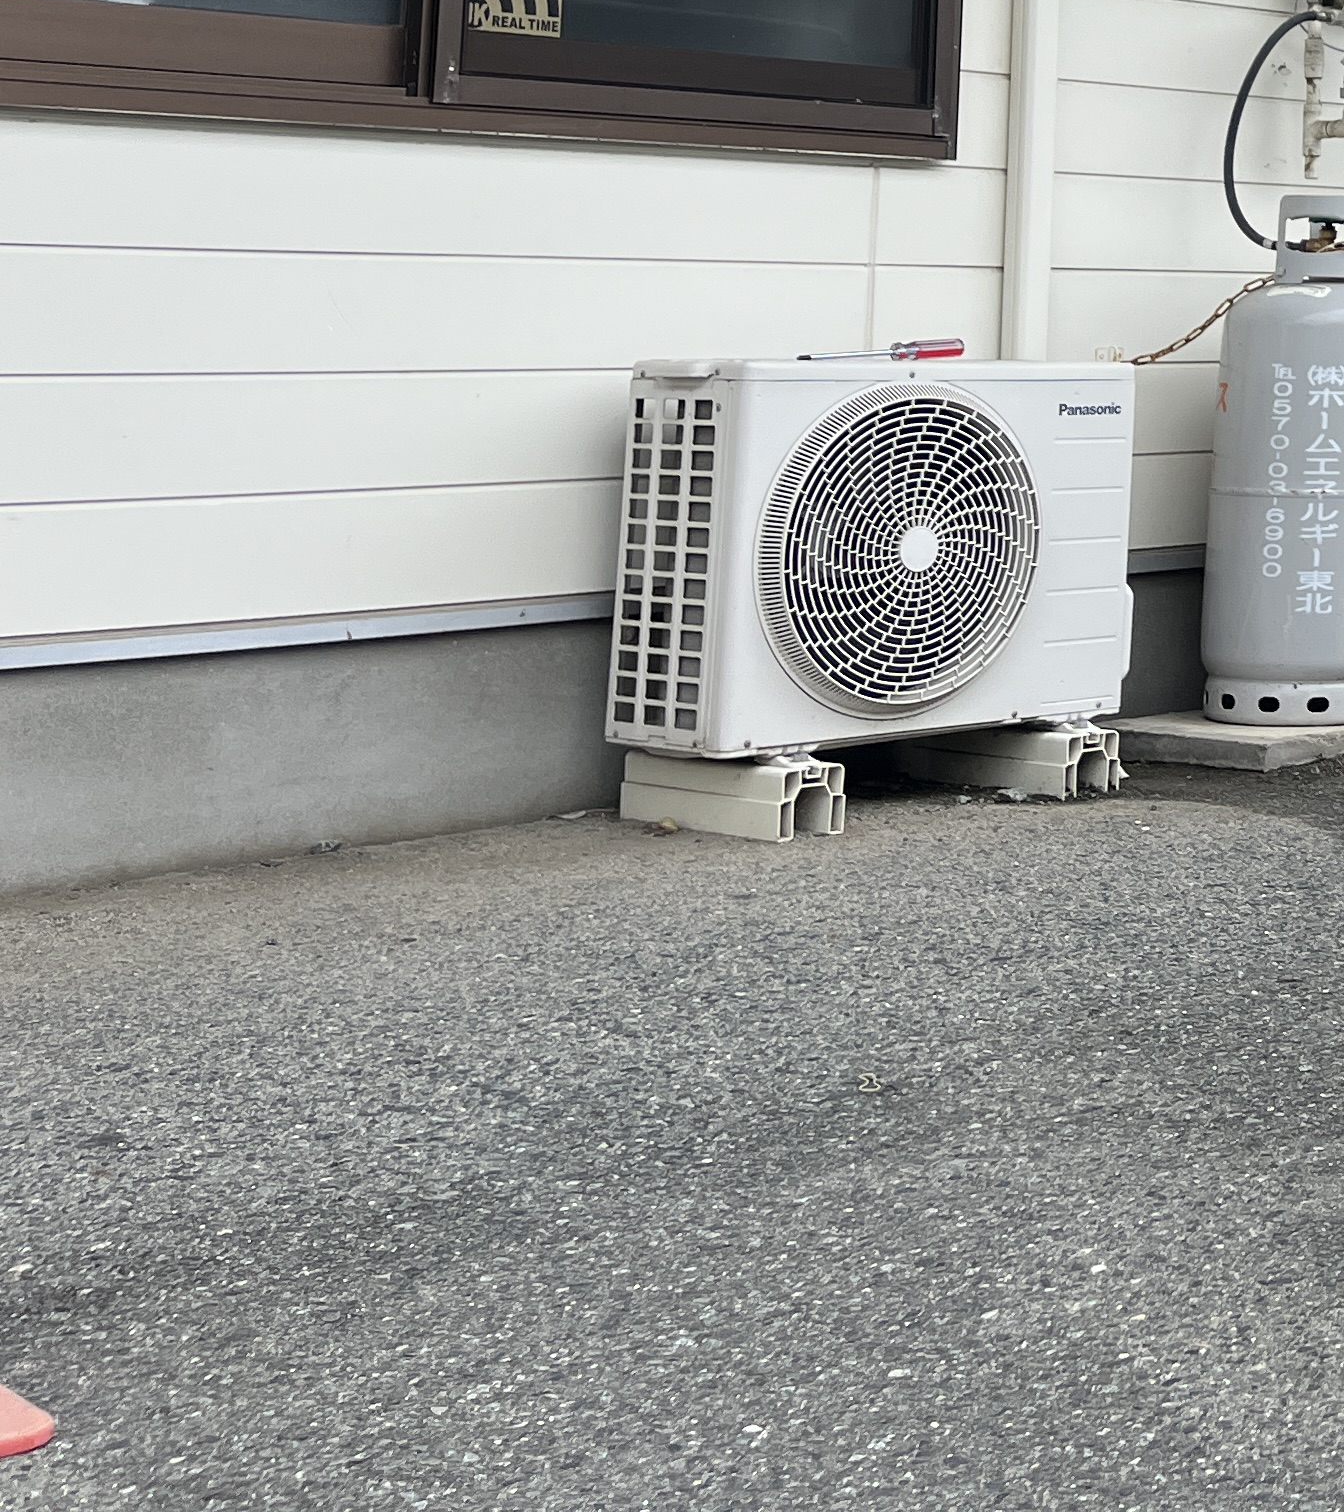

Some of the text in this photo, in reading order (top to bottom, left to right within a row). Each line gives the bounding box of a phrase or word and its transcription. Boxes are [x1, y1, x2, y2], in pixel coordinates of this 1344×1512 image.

[492, 15, 526, 30] REAL
[528, 18, 560, 33] TIME
[1058, 401, 1122, 416] Panasonic
